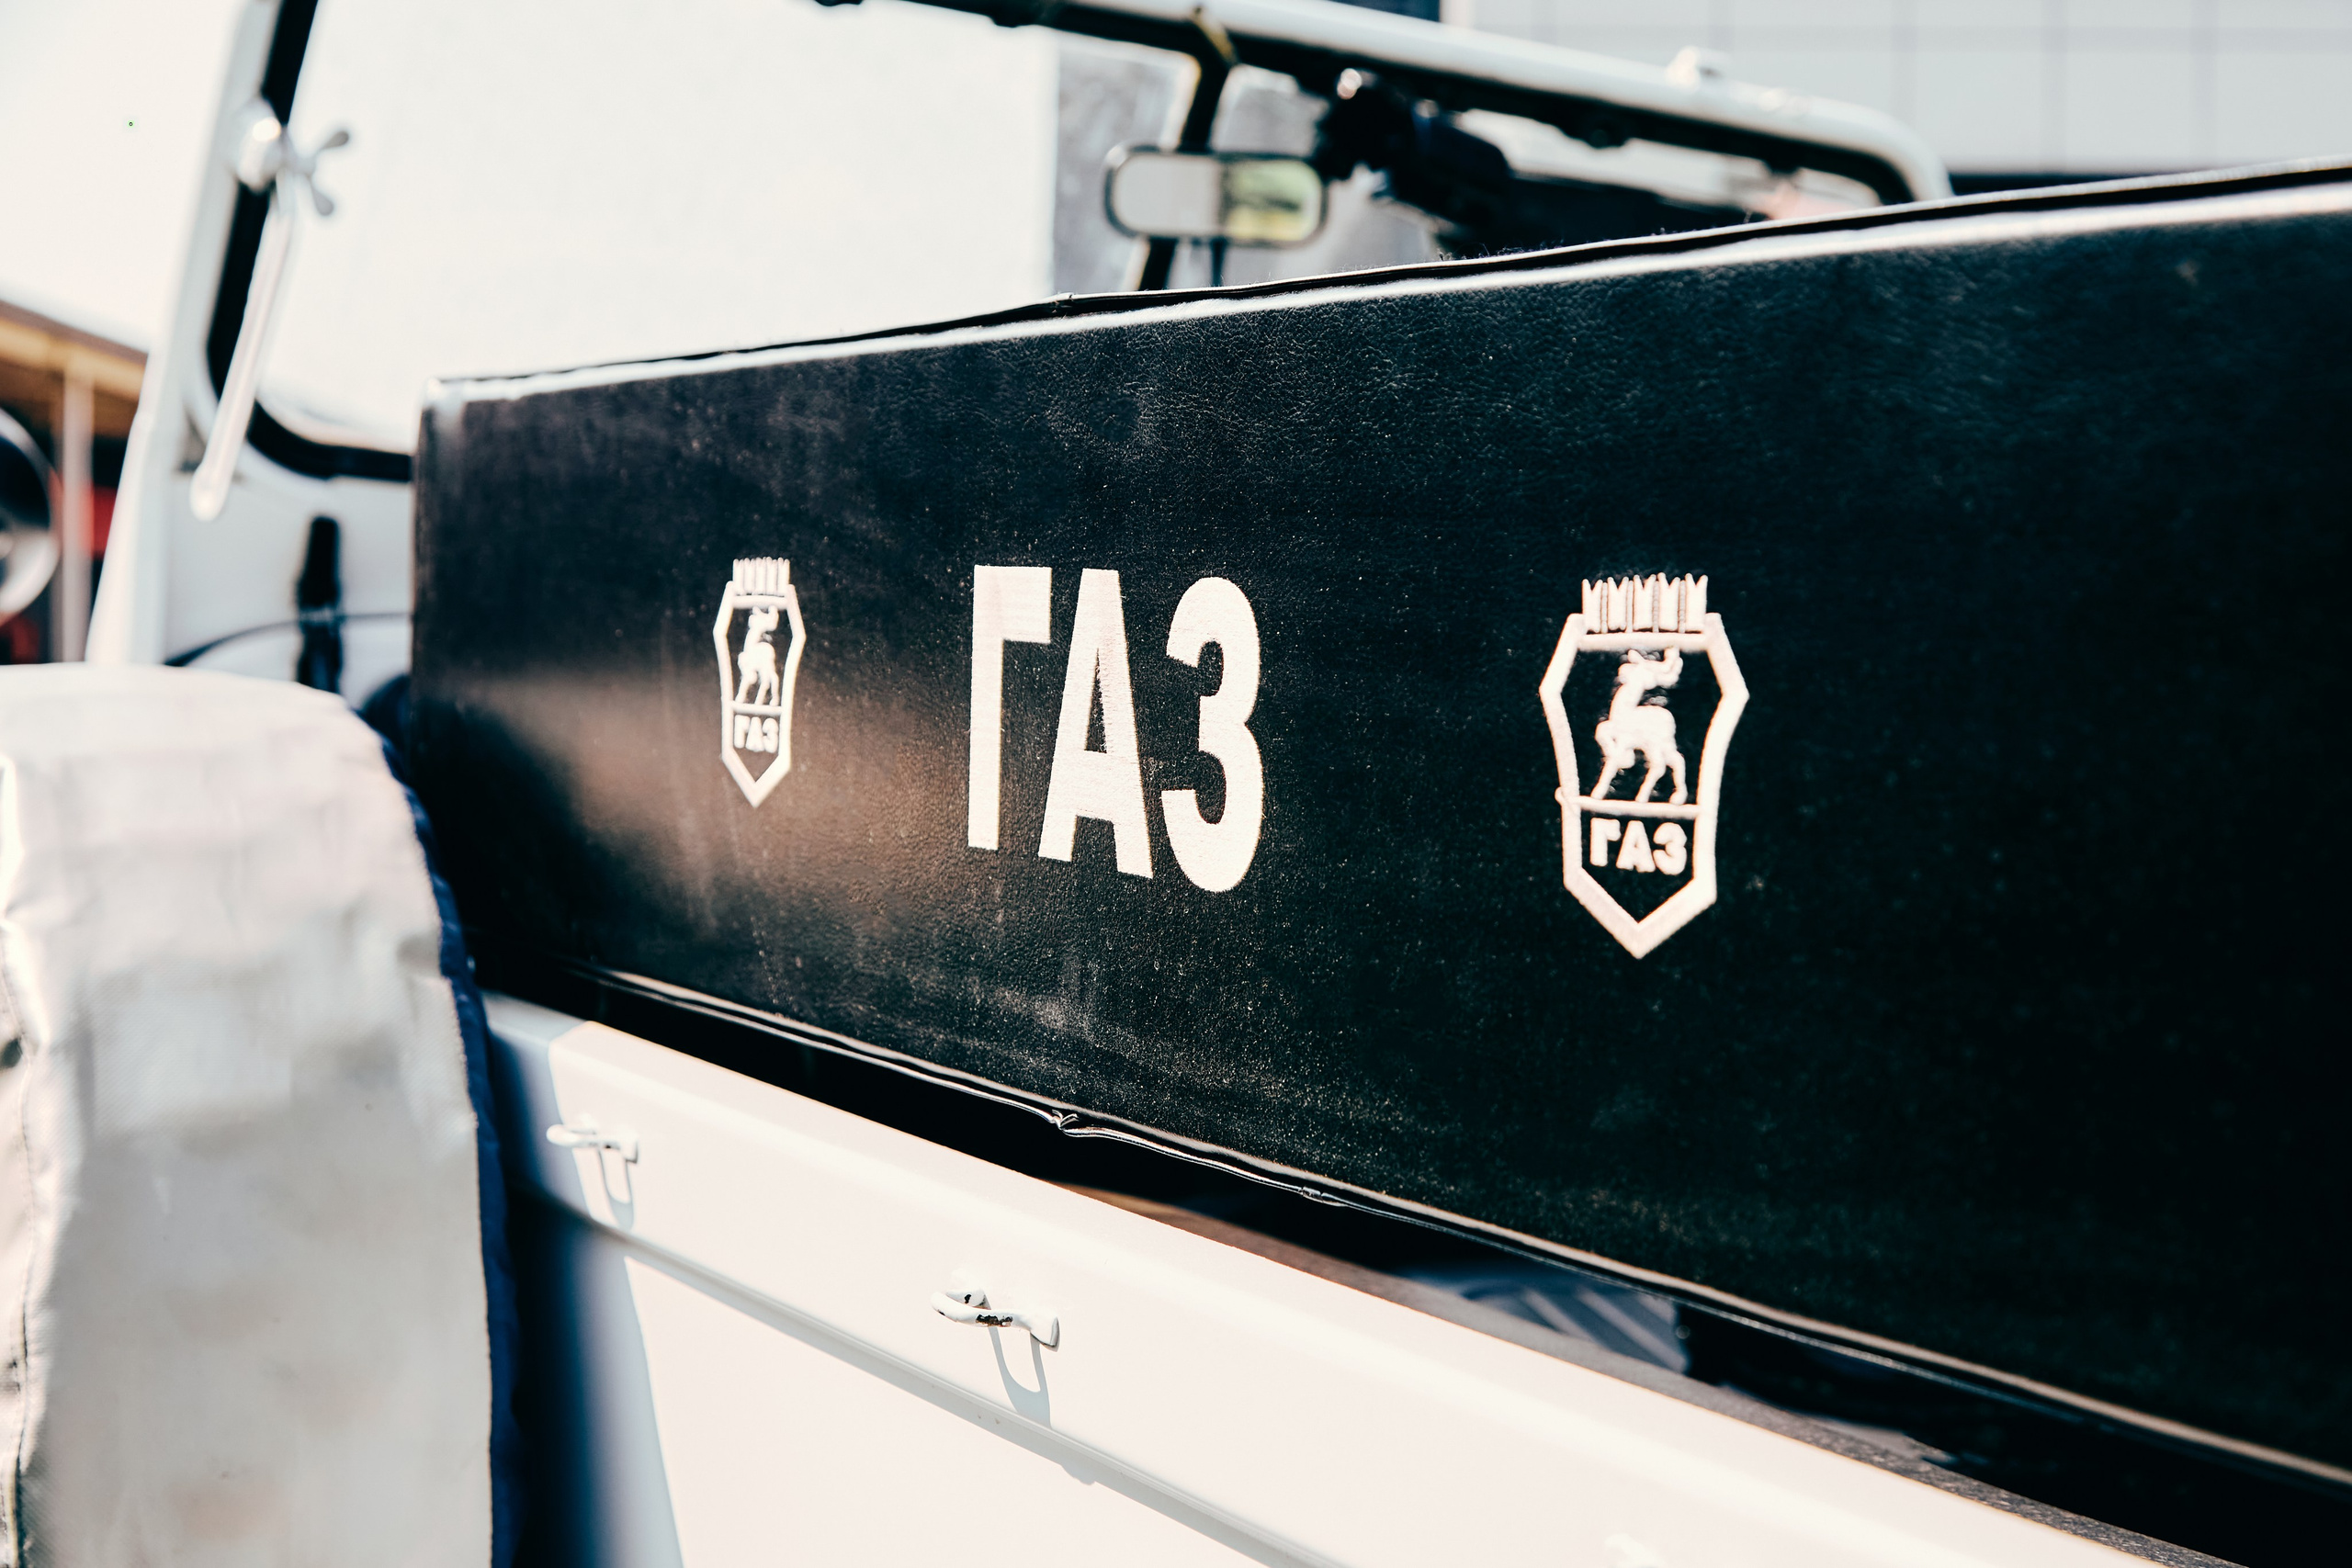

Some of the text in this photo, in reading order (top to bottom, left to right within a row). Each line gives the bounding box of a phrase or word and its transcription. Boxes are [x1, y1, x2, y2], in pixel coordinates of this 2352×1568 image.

[733, 714, 779, 753] ГАЗ
[967, 564, 1266, 893] ГАЗ
[1589, 817, 1689, 876] ГАЗ
